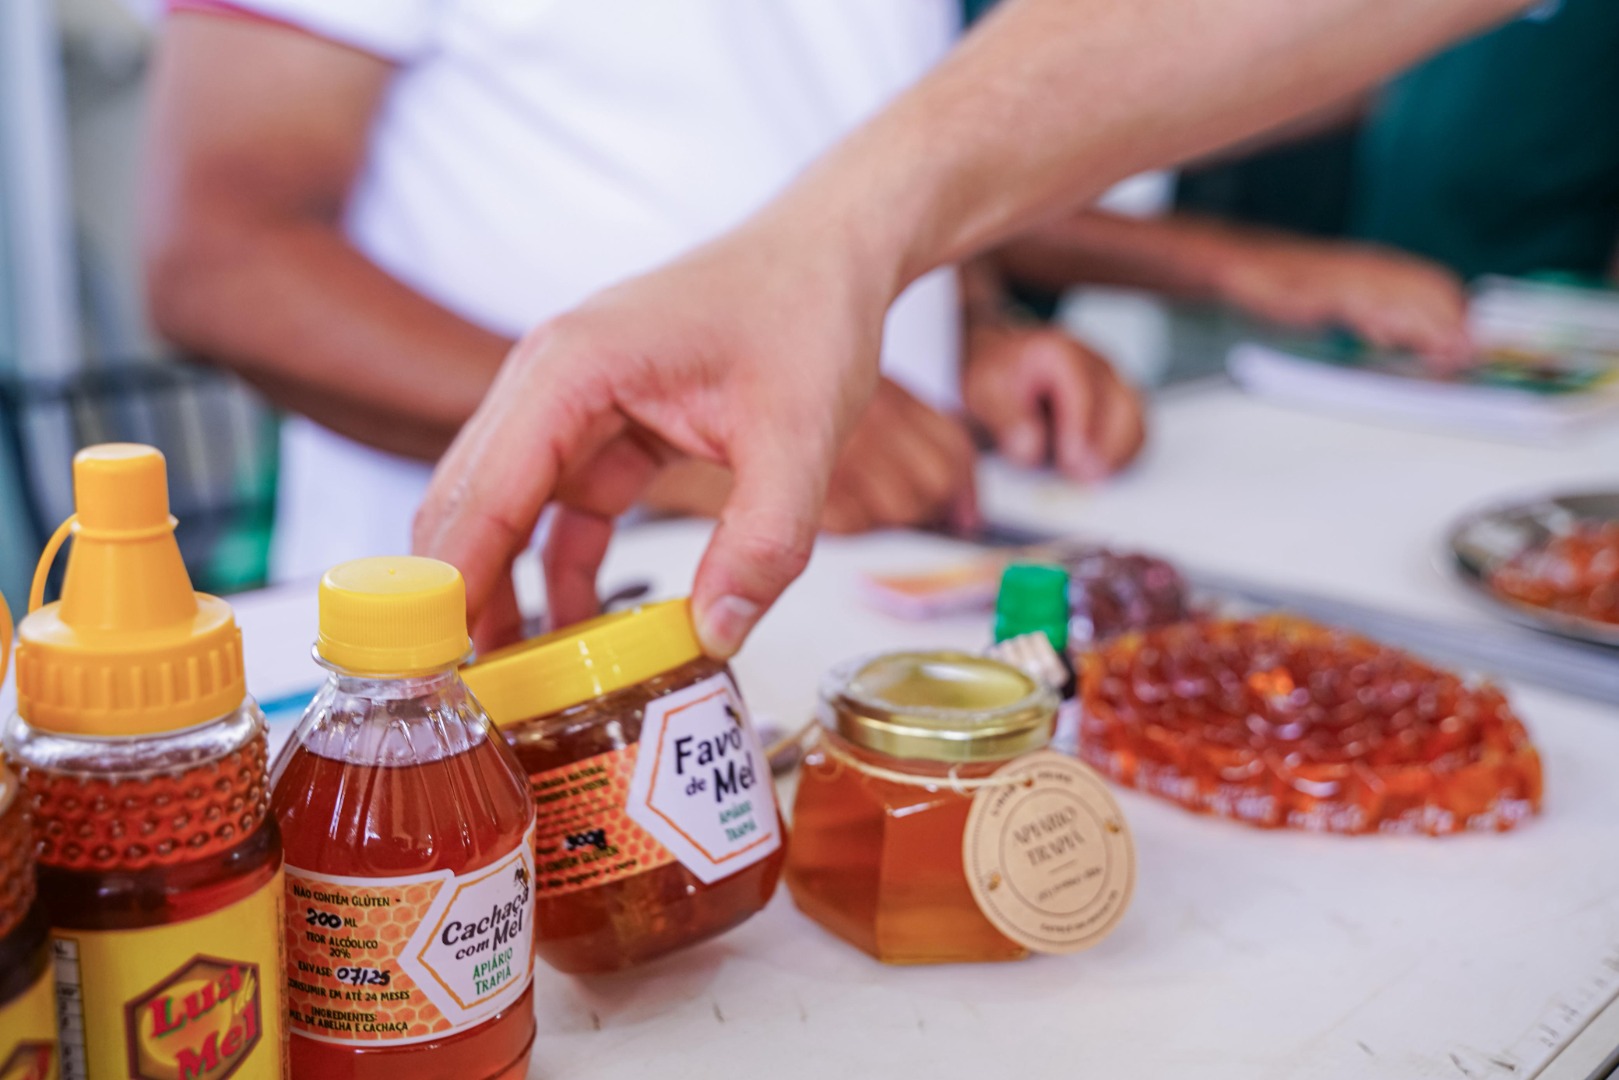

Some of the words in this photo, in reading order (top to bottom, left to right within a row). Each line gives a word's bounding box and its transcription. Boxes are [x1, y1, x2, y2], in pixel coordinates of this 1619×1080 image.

[674, 727, 742, 776] Favo
[685, 776, 706, 796] de
[714, 750, 757, 803] Mel
[293, 885, 312, 899] NÃO
[313, 891, 350, 906] CONTÉM
[351, 893, 391, 908] GLÚTEN
[306, 907, 342, 929] 200
[344, 917, 359, 928] ML
[441, 886, 529, 946] Cachaça
[306, 931, 327, 945] TEOR
[328, 936, 379, 950] ALCÓOLICO
[455, 938, 490, 960] com
[492, 908, 524, 951] Mel
[473, 946, 513, 980] APIÁRIO
[475, 960, 512, 996] TRAPIÁ
[147, 963, 243, 1039] Lua
[329, 989, 343, 1000] EM
[345, 988, 363, 1001] ATÉ
[365, 992, 378, 1001] 24
[380, 990, 411, 1002] MESES
[175, 999, 257, 1080] Mel
[305, 1014, 316, 1026] DE
[317, 1018, 353, 1032] ABELHA
[355, 1022, 361, 1033] E
[362, 1021, 409, 1034] CACHAÇA
